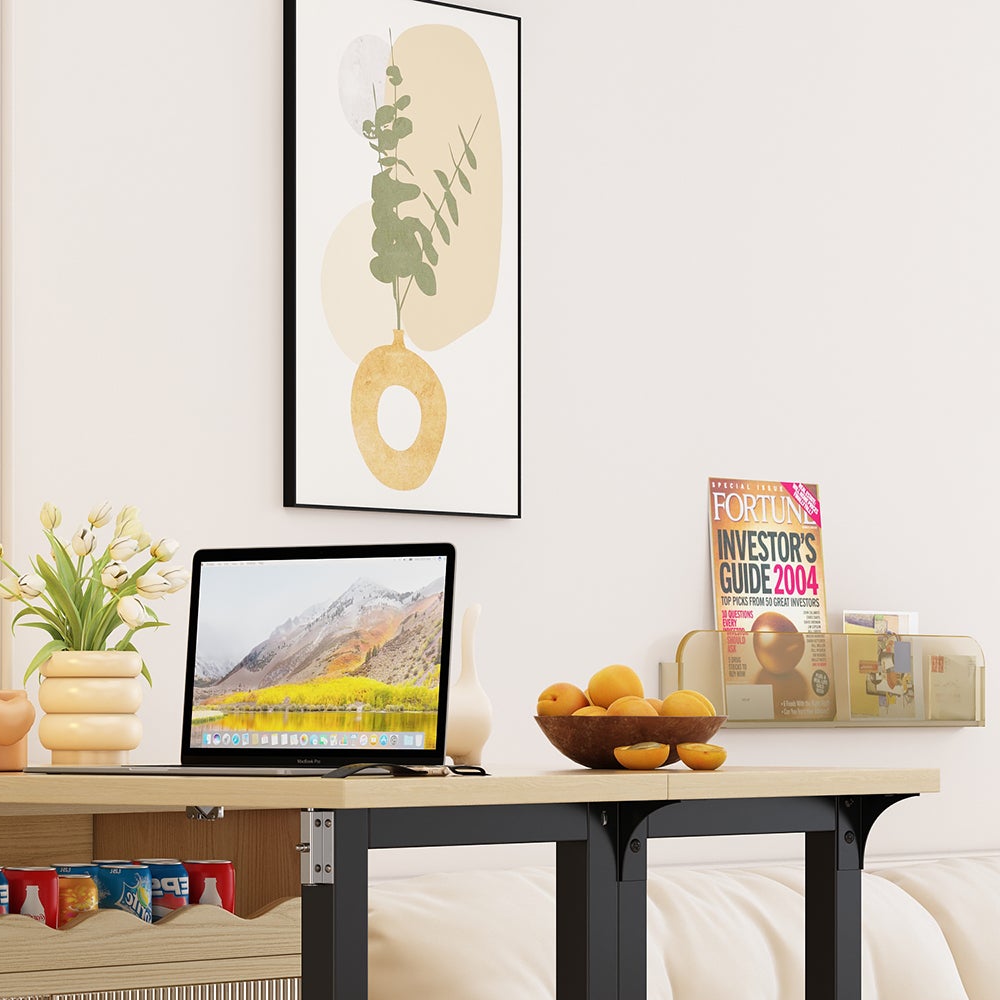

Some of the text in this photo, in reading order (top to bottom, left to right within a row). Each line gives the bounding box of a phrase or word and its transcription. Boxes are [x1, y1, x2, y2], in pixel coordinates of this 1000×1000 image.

[711, 481, 751, 490] SPECIAL
[717, 529, 818, 564] INVESTOR'S
[720, 561, 819, 596] GUIDE 2004
[721, 596, 820, 608] TOP PICKS FROM 50 GREAT INVESTORS
[728, 610, 754, 619] QUESTIONS
[722, 618, 737, 628] EVERY
